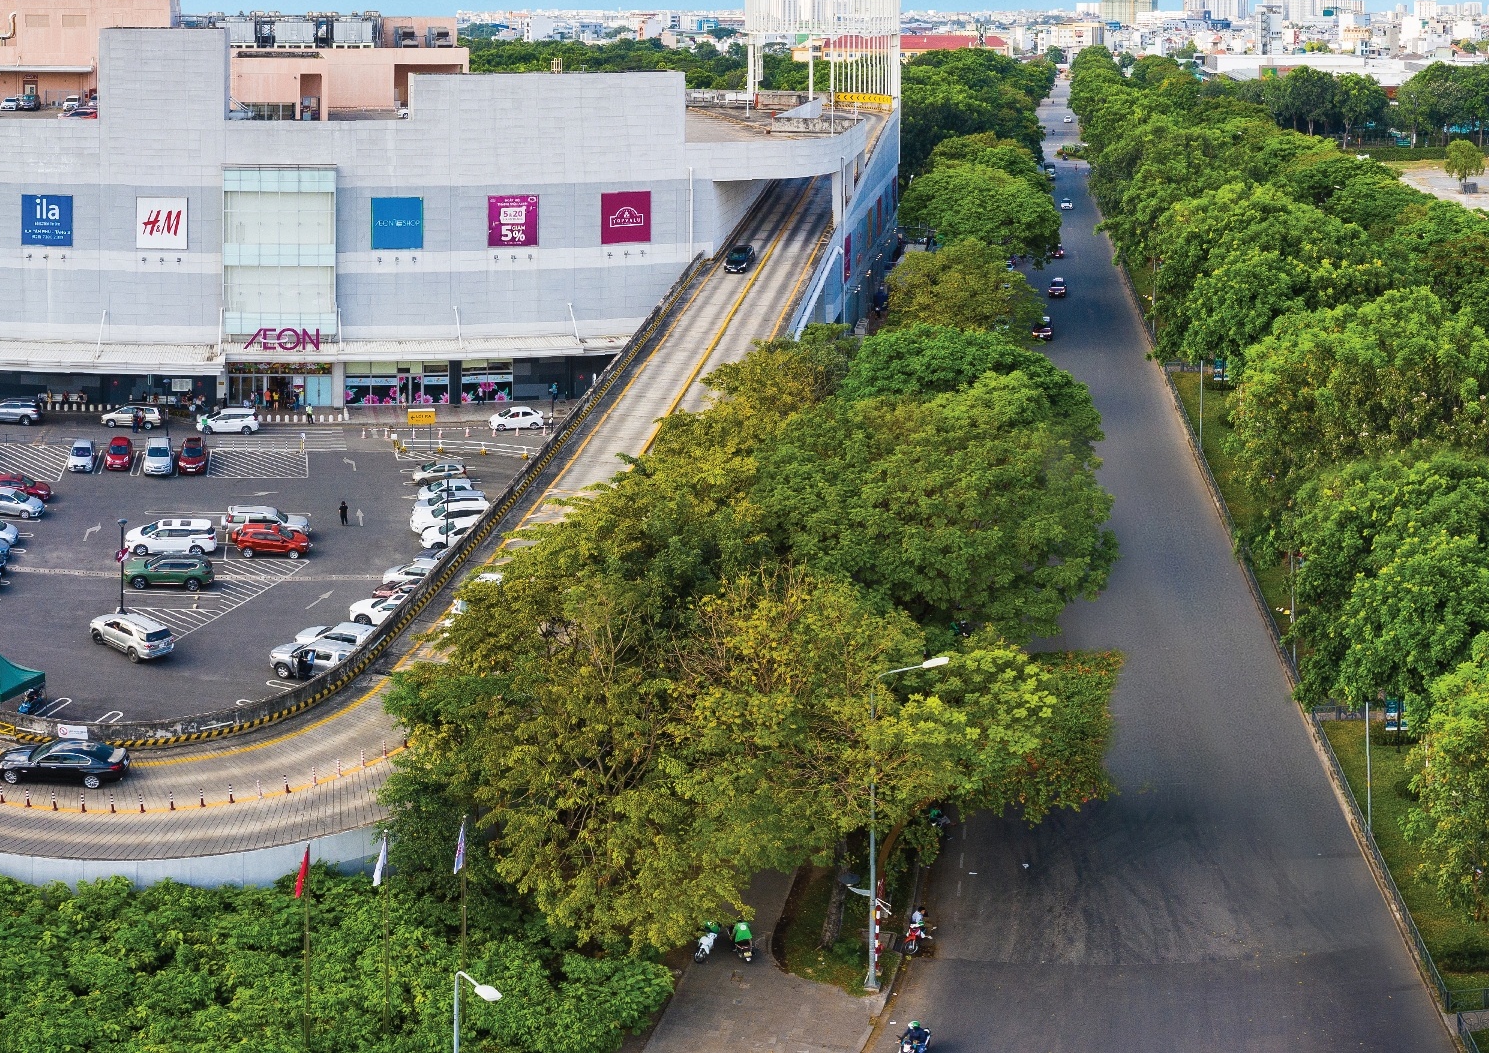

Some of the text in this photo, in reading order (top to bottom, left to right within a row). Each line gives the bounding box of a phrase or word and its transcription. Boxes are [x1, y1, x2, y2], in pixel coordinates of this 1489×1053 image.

[35, 198, 60, 219] ila
[512, 210, 523, 218] 20
[142, 209, 182, 237] H&M
[501, 225, 526, 241] 5%
